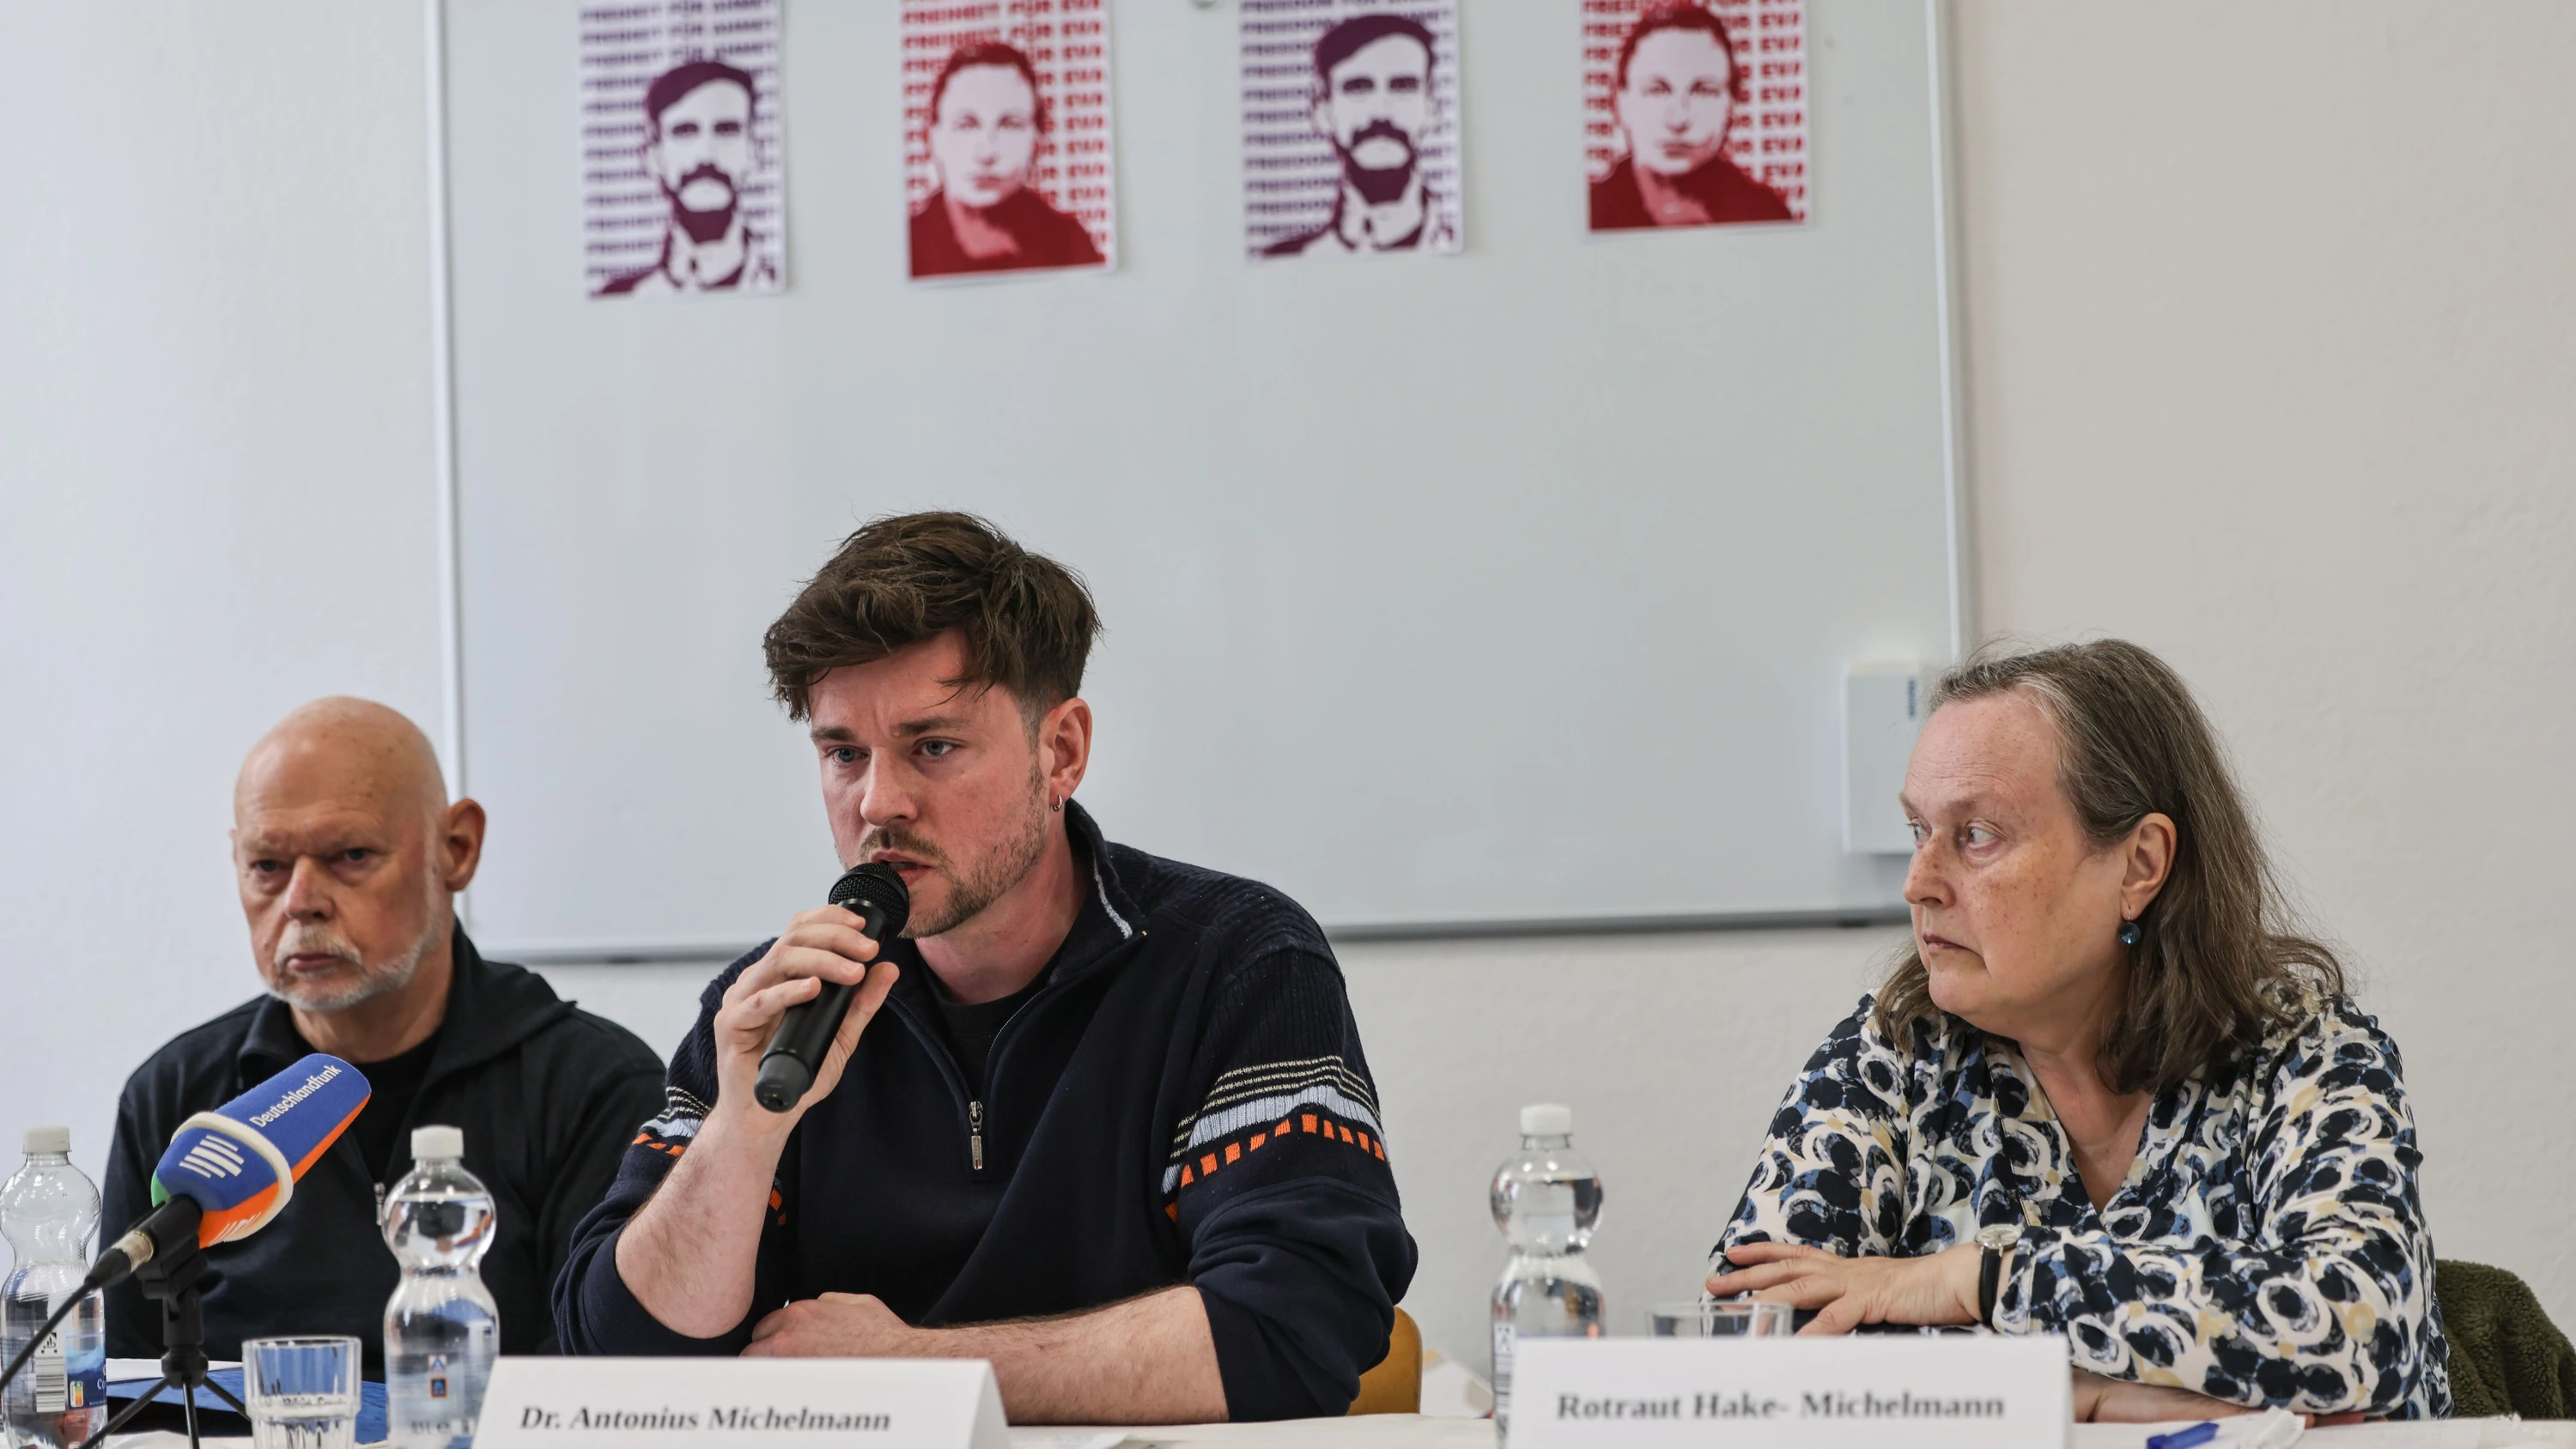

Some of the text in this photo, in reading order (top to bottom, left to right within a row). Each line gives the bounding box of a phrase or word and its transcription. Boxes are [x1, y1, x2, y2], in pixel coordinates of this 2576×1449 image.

[249, 1065, 342, 1127] Deutschlandfunk
[519, 1406, 890, 1430] Dr. Antonius Michelmann
[1557, 1391, 2005, 1418] Rotraut Hake- Michelmann
